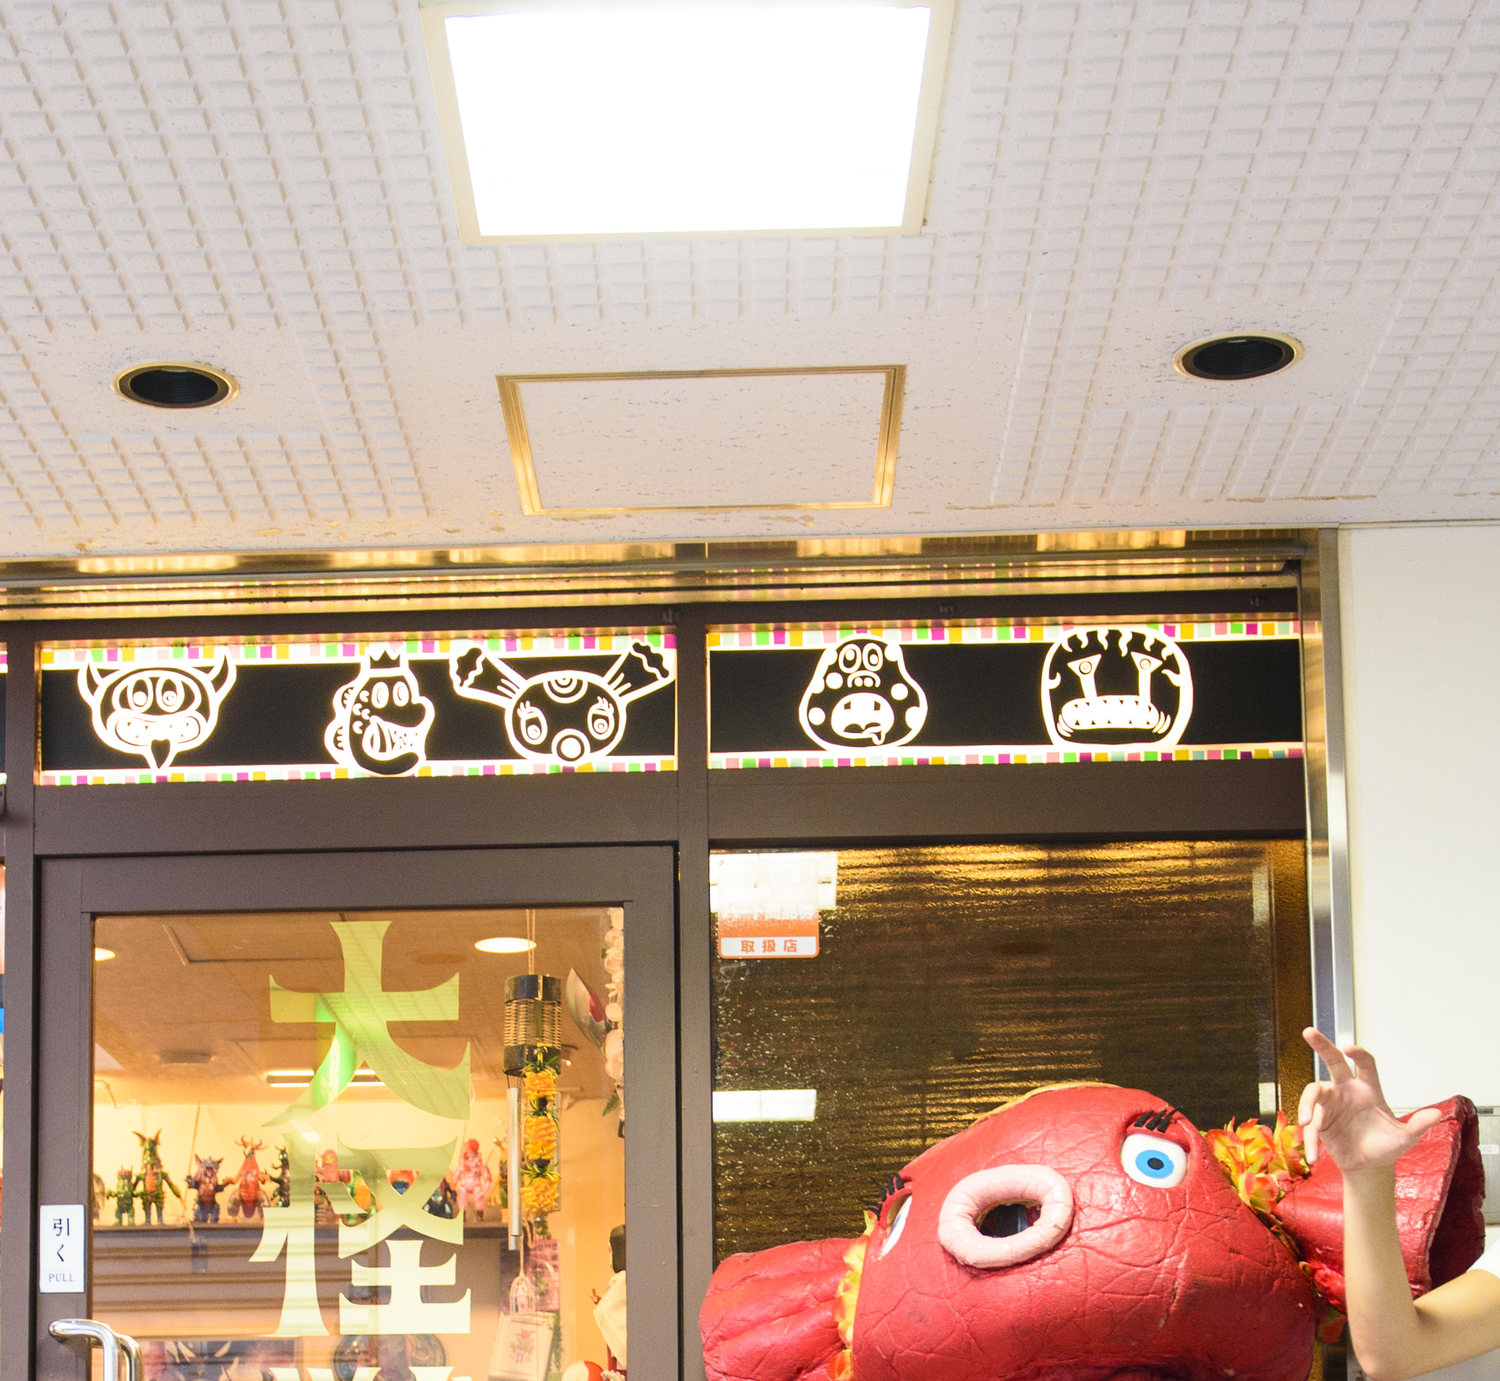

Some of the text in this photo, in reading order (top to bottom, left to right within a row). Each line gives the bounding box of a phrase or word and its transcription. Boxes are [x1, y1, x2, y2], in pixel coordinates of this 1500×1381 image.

[740, 940, 798, 953] 取扱店
[52, 1218, 70, 1262] 引く
[48, 1273, 75, 1282] PULL
